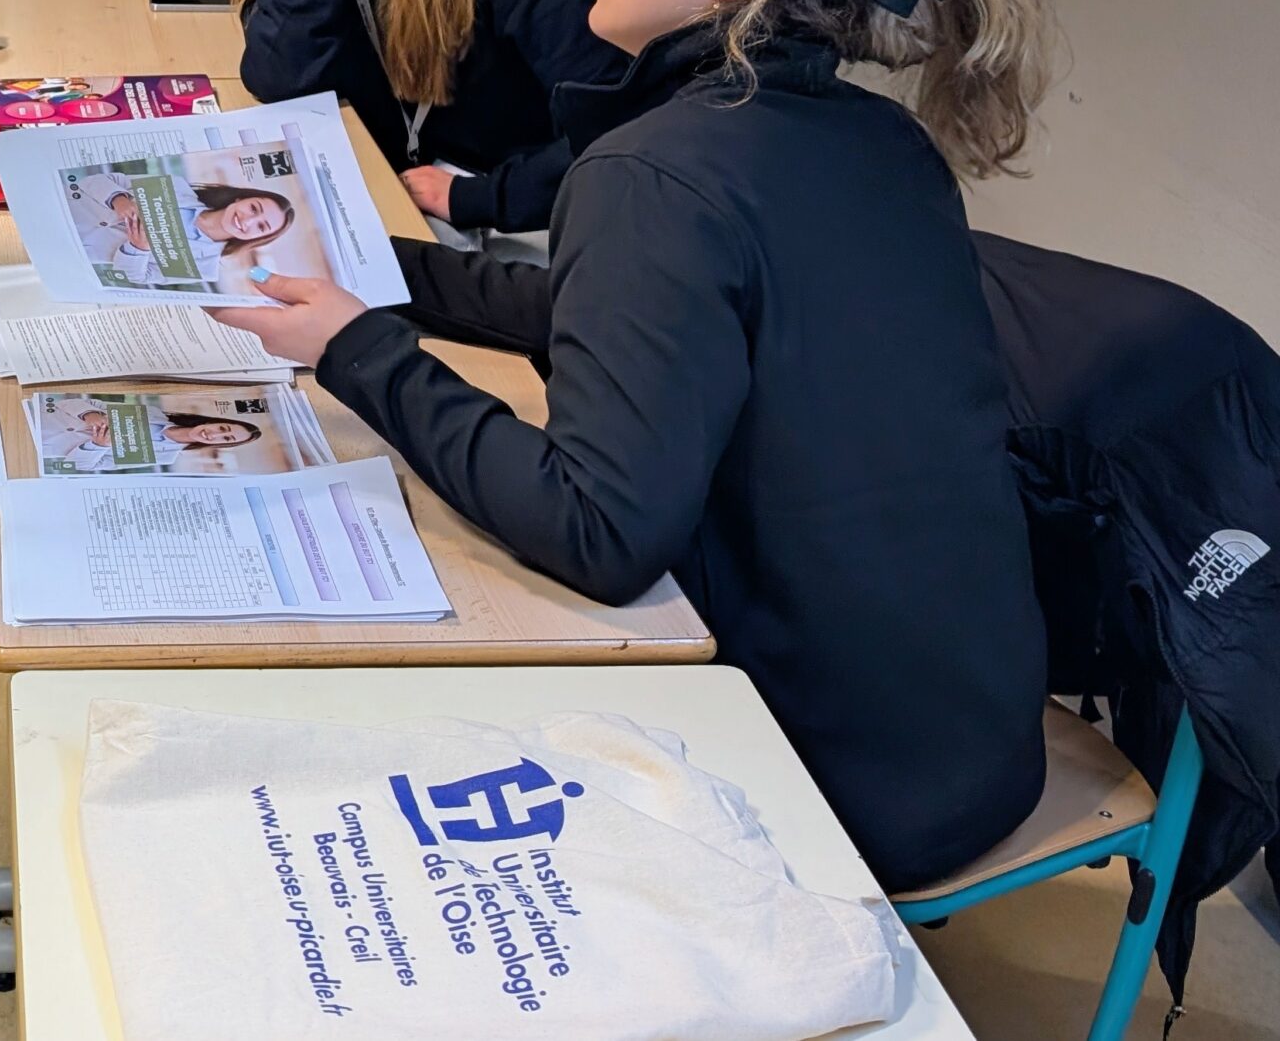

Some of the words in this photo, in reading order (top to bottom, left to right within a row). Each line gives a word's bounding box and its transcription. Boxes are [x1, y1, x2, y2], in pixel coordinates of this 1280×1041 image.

[137, 187, 169, 269] commercialisation
[152, 195, 174, 248] Techniques
[167, 247, 179, 261] de
[1183, 549, 1233, 601] NORTH
[1188, 539, 1220, 569] THE
[1206, 560, 1246, 599] FACE
[251, 785, 353, 1017] www.iut-oise.u-picardie.fr
[313, 831, 358, 908] Beauvais
[345, 924, 382, 963] Creil
[338, 802, 374, 868] Campus
[362, 872, 417, 987] Universitaires
[422, 853, 455, 881] de
[457, 859, 489, 878] de
[528, 847, 582, 916] Institut
[434, 883, 476, 955] l'Oise
[472, 882, 547, 1013] Technologie
[492, 853, 570, 977] Universitaire
